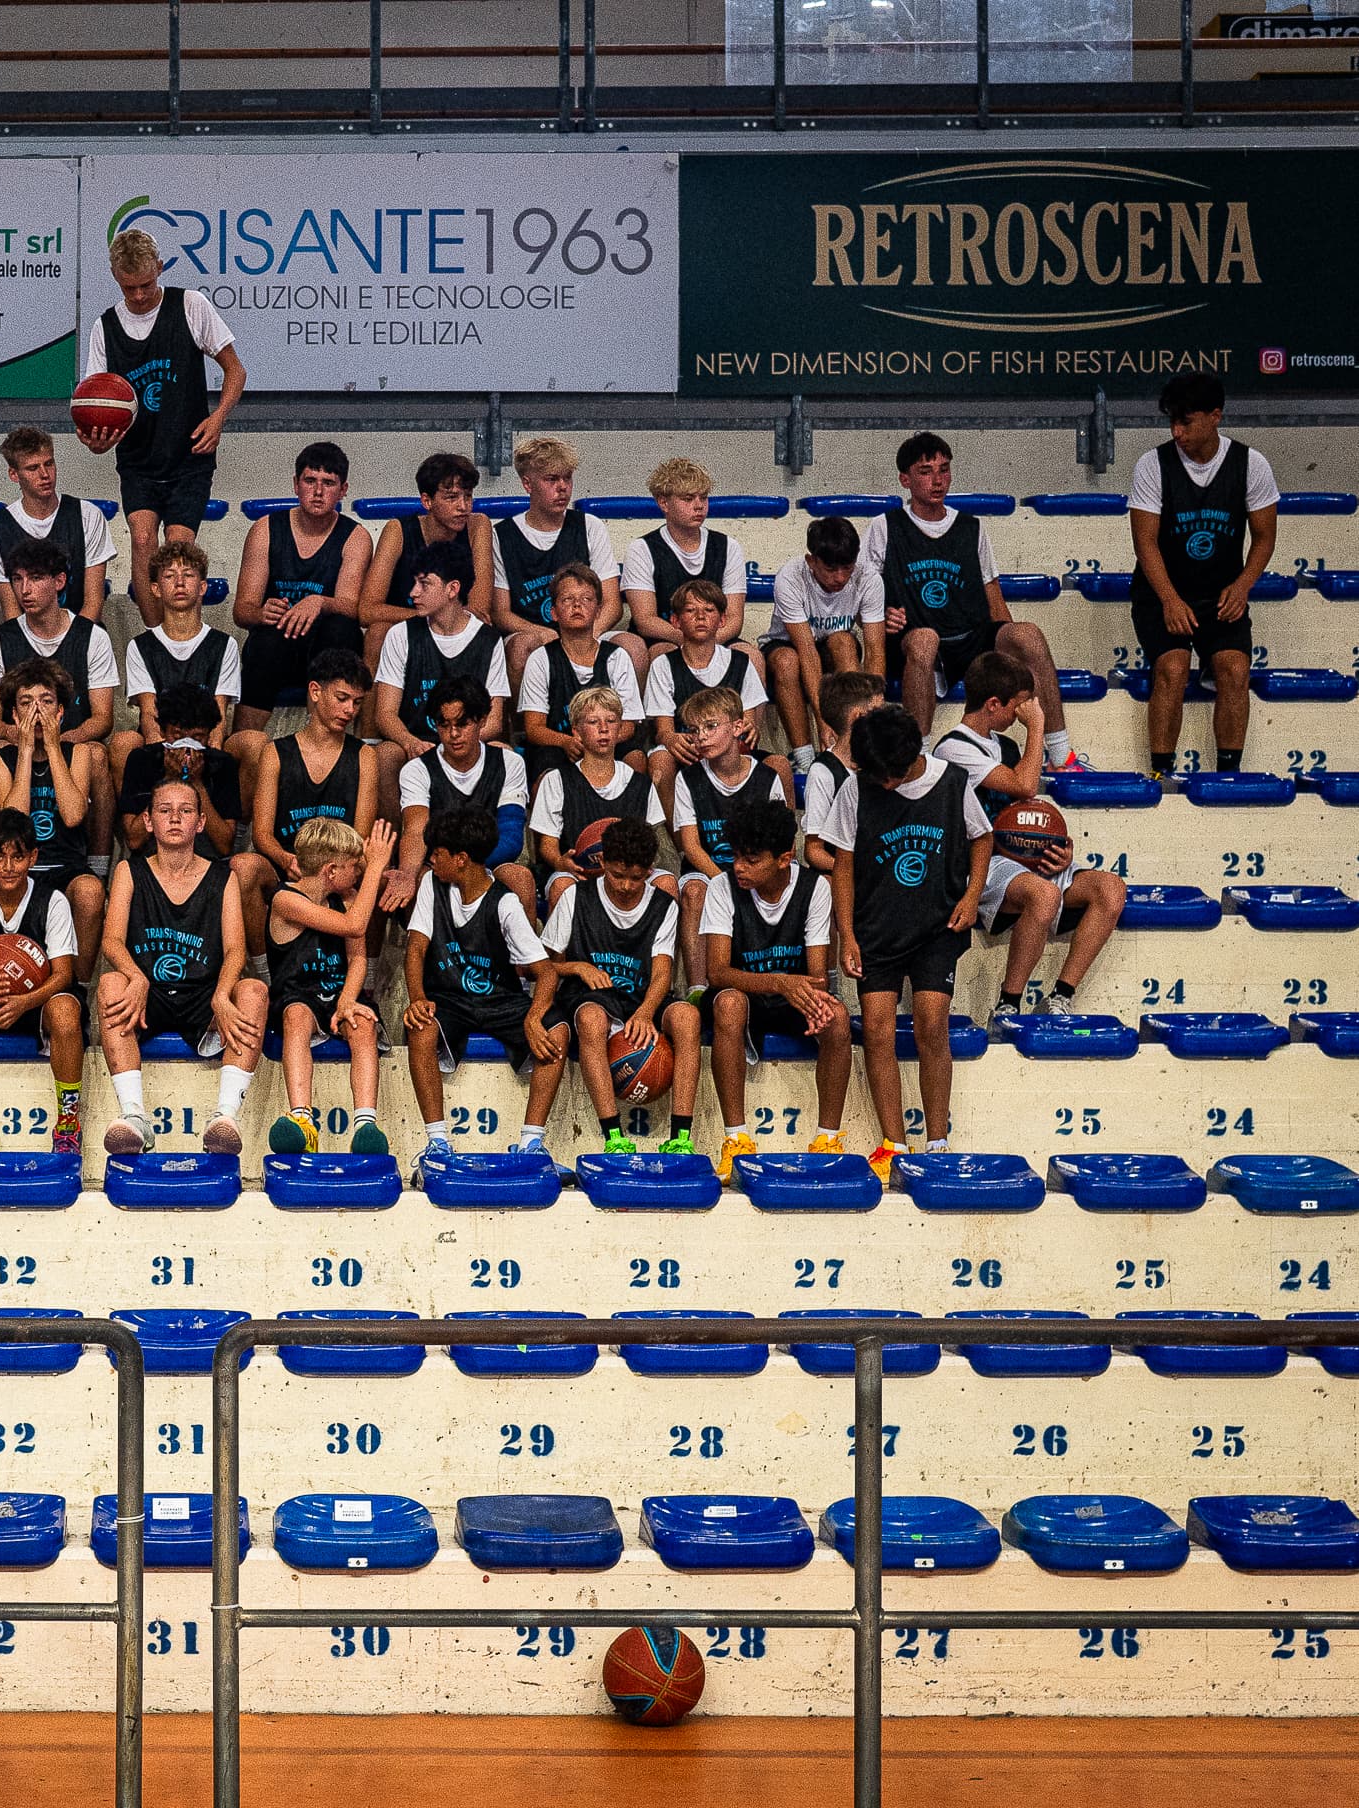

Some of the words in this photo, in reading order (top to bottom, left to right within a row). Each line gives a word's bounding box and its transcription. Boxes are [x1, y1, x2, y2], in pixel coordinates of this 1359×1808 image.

[27, 227, 62, 254] srl
[811, 201, 1263, 287] RETROSCENA
[22, 258, 61, 278] Inerte
[359, 285, 372, 309] E
[382, 285, 575, 309] TECNOLOGIE
[286, 321, 337, 345] PER
[696, 352, 760, 376] NEW
[771, 351, 931, 376] DIMENSION
[942, 351, 982, 375] OF
[991, 351, 1044, 375] FISH
[1055, 350, 1232, 374] RESTAURANT
[1176, 509, 1231, 523] TRANORMING
[1252, 647, 1269, 668] 2
[1287, 750, 1327, 772] 22
[881, 824, 944, 845] TRANSFORMING
[1086, 853, 1129, 877] 24
[1223, 854, 1263, 876] 23
[145, 928, 204, 949] TRANSFORMING
[135, 941, 208, 965] BASKETBALL
[1143, 980, 1184, 1005] 24
[1285, 980, 1326, 1004] 23
[3, 1108, 47, 1134] 32
[154, 1108, 192, 1134] 31
[451, 1108, 498, 1134] 29
[629, 1107, 649, 1133] 8
[756, 1109, 799, 1135] 27
[1056, 1109, 1100, 1135] 25
[1208, 1109, 1253, 1136] 24
[152, 1257, 194, 1285] 31
[312, 1259, 362, 1286] 30
[471, 1260, 520, 1288] 29
[630, 1259, 680, 1288] 28
[795, 1259, 844, 1288] 27
[952, 1259, 1002, 1288] 26
[1117, 1261, 1164, 1288] 25
[1280, 1261, 1330, 1290] 24
[159, 1424, 203, 1454] 31
[327, 1424, 381, 1454] 30
[501, 1425, 554, 1456] 29
[670, 1426, 723, 1458] 28
[1013, 1425, 1067, 1456] 26
[1193, 1426, 1244, 1457] 25
[147, 1620, 199, 1654] 31
[331, 1627, 390, 1656] 30
[516, 1627, 575, 1657] 29
[706, 1627, 766, 1658] 28
[895, 1628, 950, 1658] 27
[1079, 1628, 1139, 1658] 26
[1271, 1628, 1330, 1658] 25
